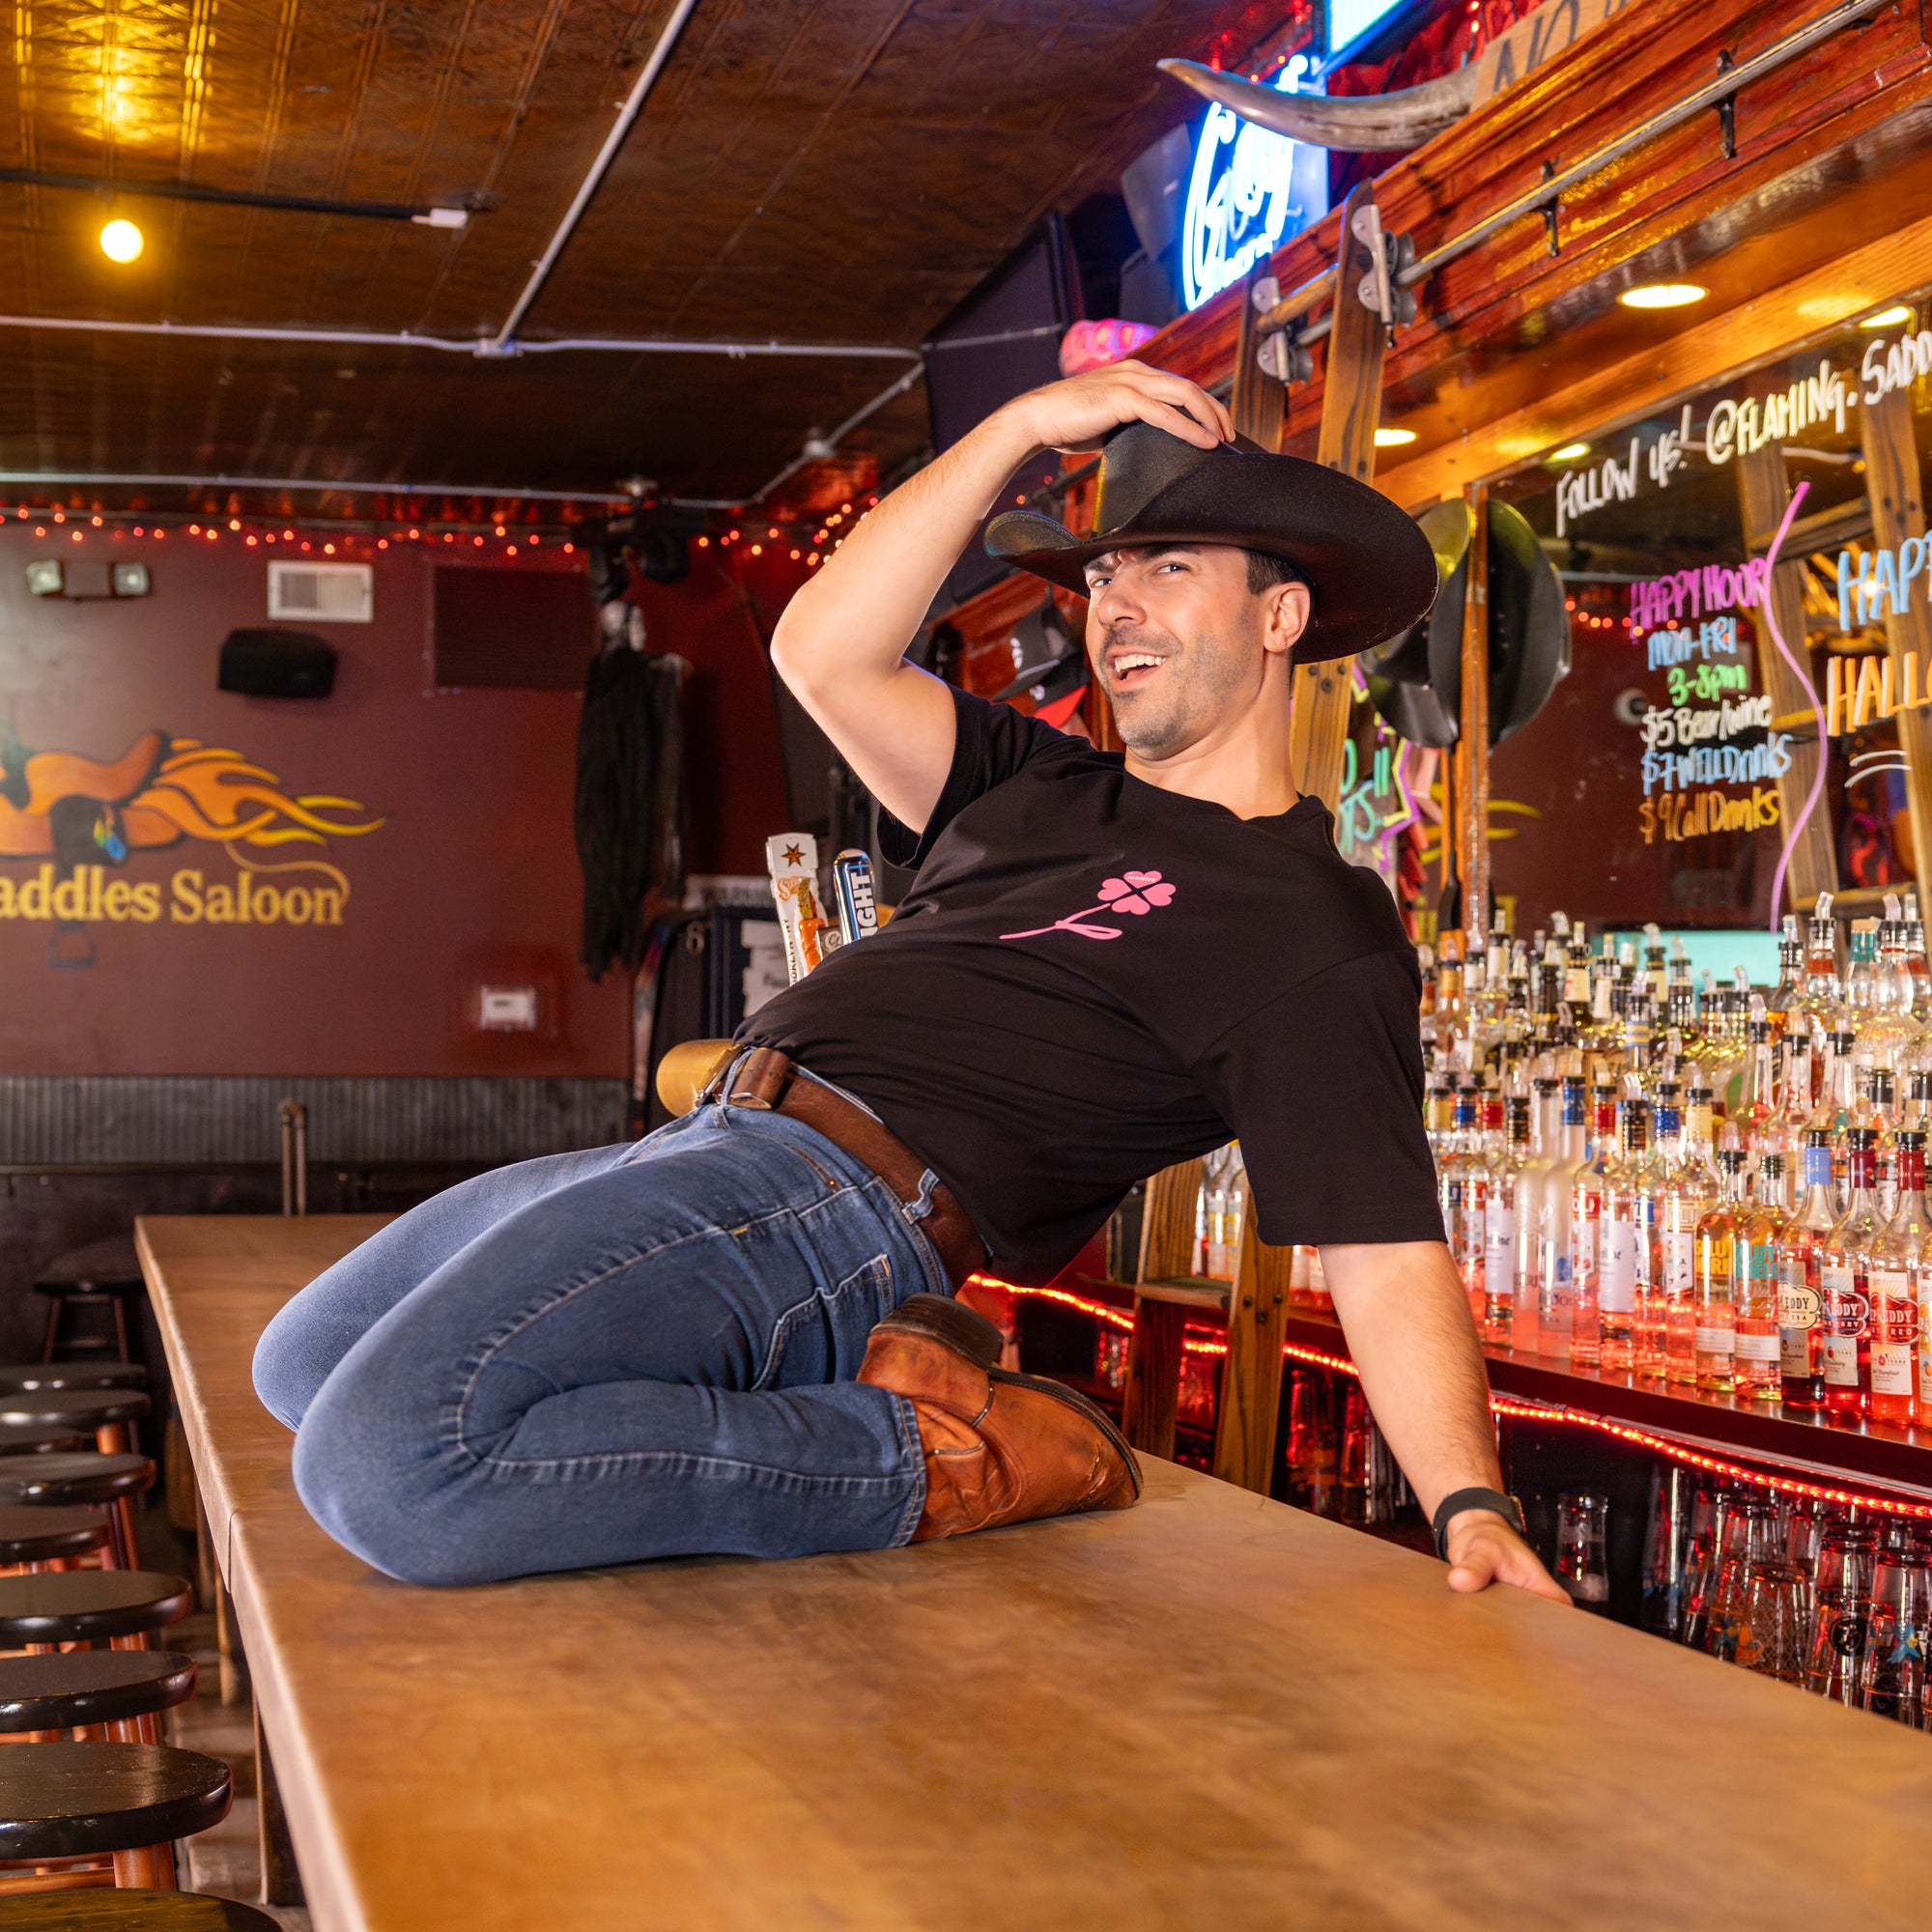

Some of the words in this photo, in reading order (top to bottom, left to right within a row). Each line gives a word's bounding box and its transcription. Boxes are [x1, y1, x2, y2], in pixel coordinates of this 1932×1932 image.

[1556, 437, 1639, 538] FOLLOW
[1629, 566, 1702, 644] HAPPY
[1639, 705, 1676, 752] $5
[1641, 748, 1677, 796] $7
[1638, 795, 1674, 844] $9
[170, 867, 345, 925] Saloon
[1889, 1327, 1913, 1336] RED
